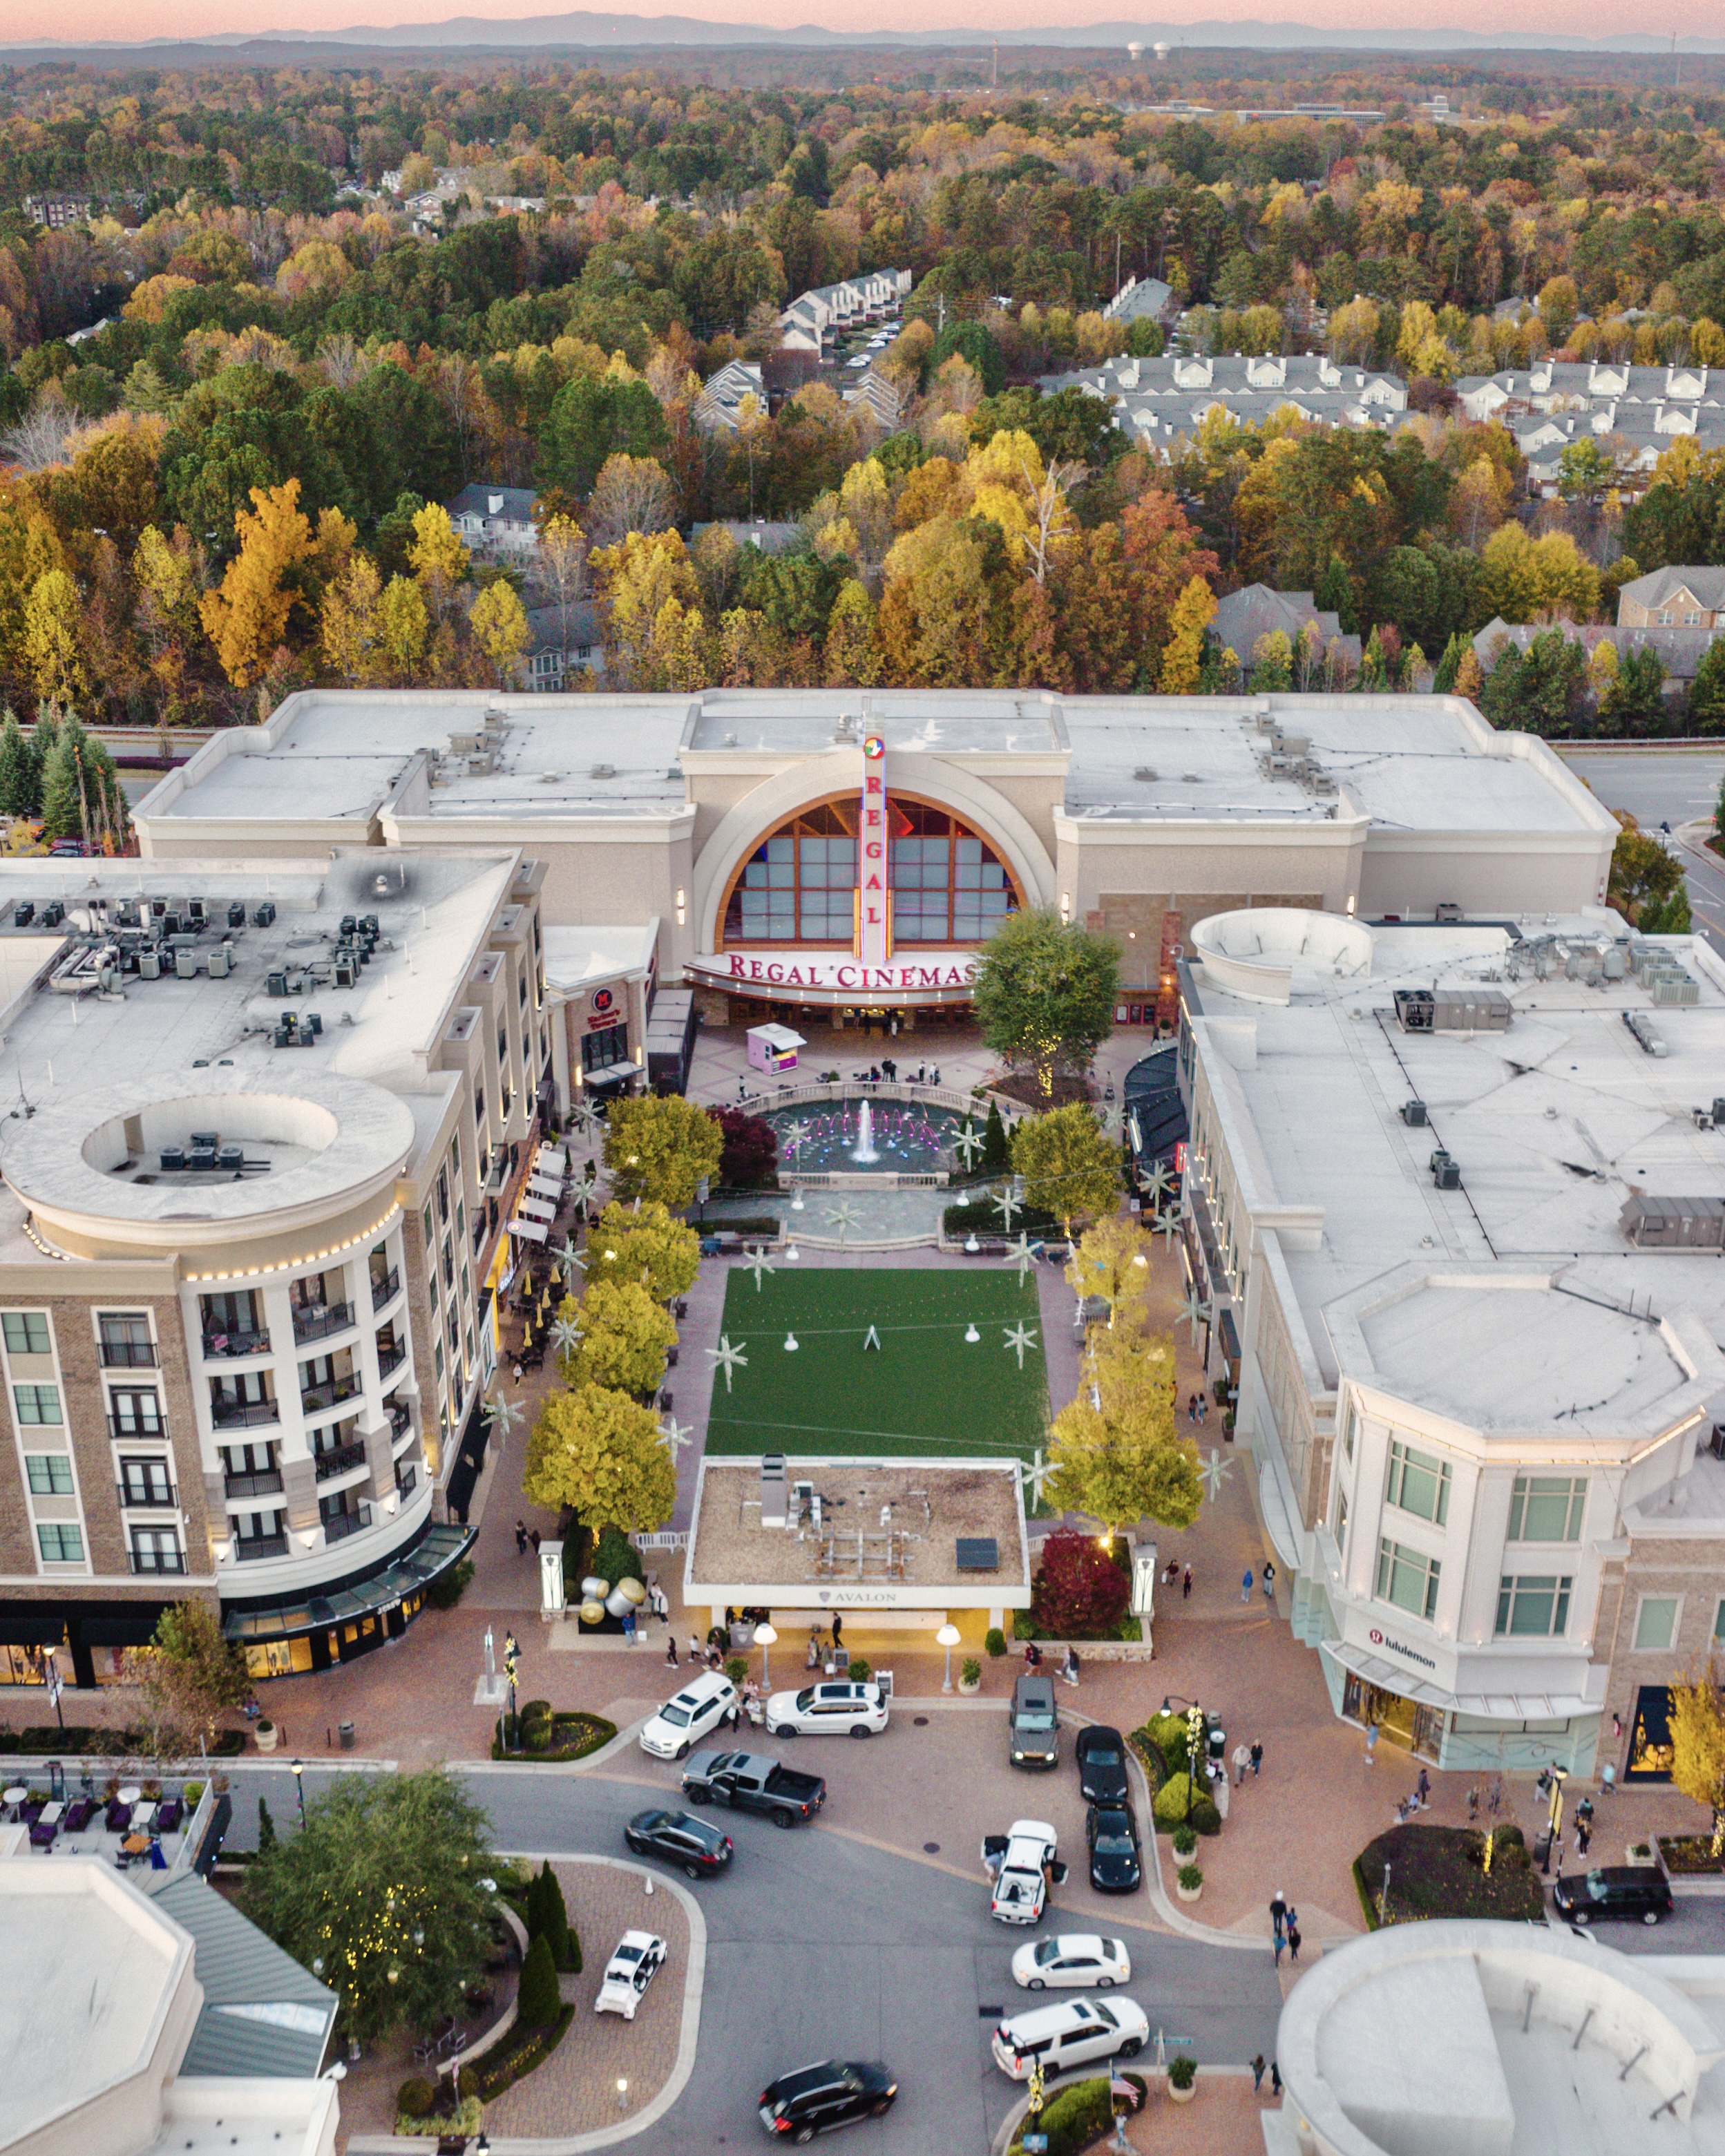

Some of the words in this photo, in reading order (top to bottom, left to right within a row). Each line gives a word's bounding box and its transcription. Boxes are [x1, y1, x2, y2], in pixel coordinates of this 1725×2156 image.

[865, 776, 883, 924] REGAL
[729, 954, 823, 984] REGAL
[837, 964, 977, 988] CINEMAS
[835, 1592, 897, 1602] AVALON
[1385, 1636, 1436, 1670] lululemon
